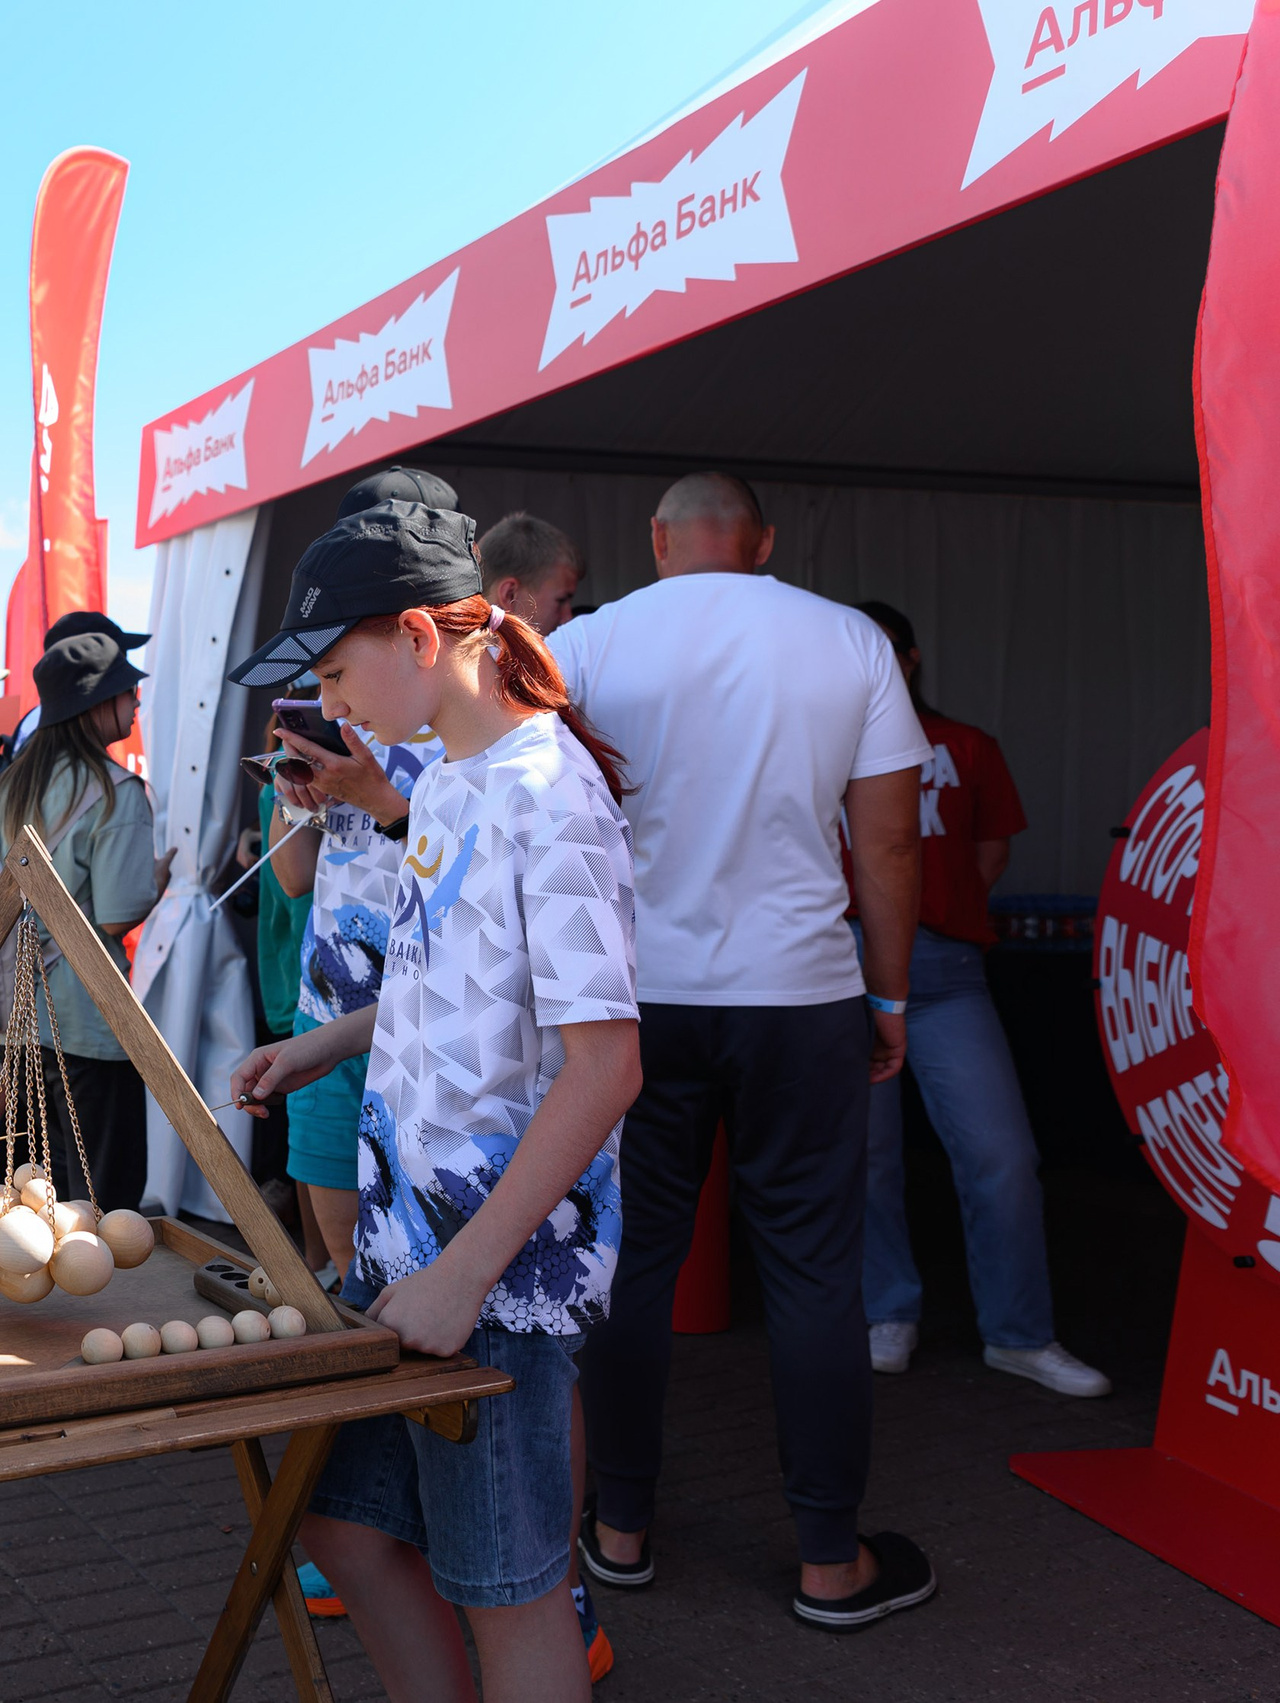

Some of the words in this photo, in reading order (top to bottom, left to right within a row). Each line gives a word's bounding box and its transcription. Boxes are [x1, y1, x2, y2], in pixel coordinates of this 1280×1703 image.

[571, 219, 668, 292] Альфа
[675, 169, 762, 241] Банк
[322, 363, 380, 411] Альфа
[384, 337, 434, 382] Банк
[162, 445, 201, 484] Альфа
[203, 431, 237, 463] Банк
[299, 586, 314, 614] MAD
[302, 586, 322, 618] WAVE
[1119, 763, 1206, 917] СПОР
[1099, 915, 1208, 1074] ВЫБИР
[1135, 1062, 1246, 1230] СПОРТ
